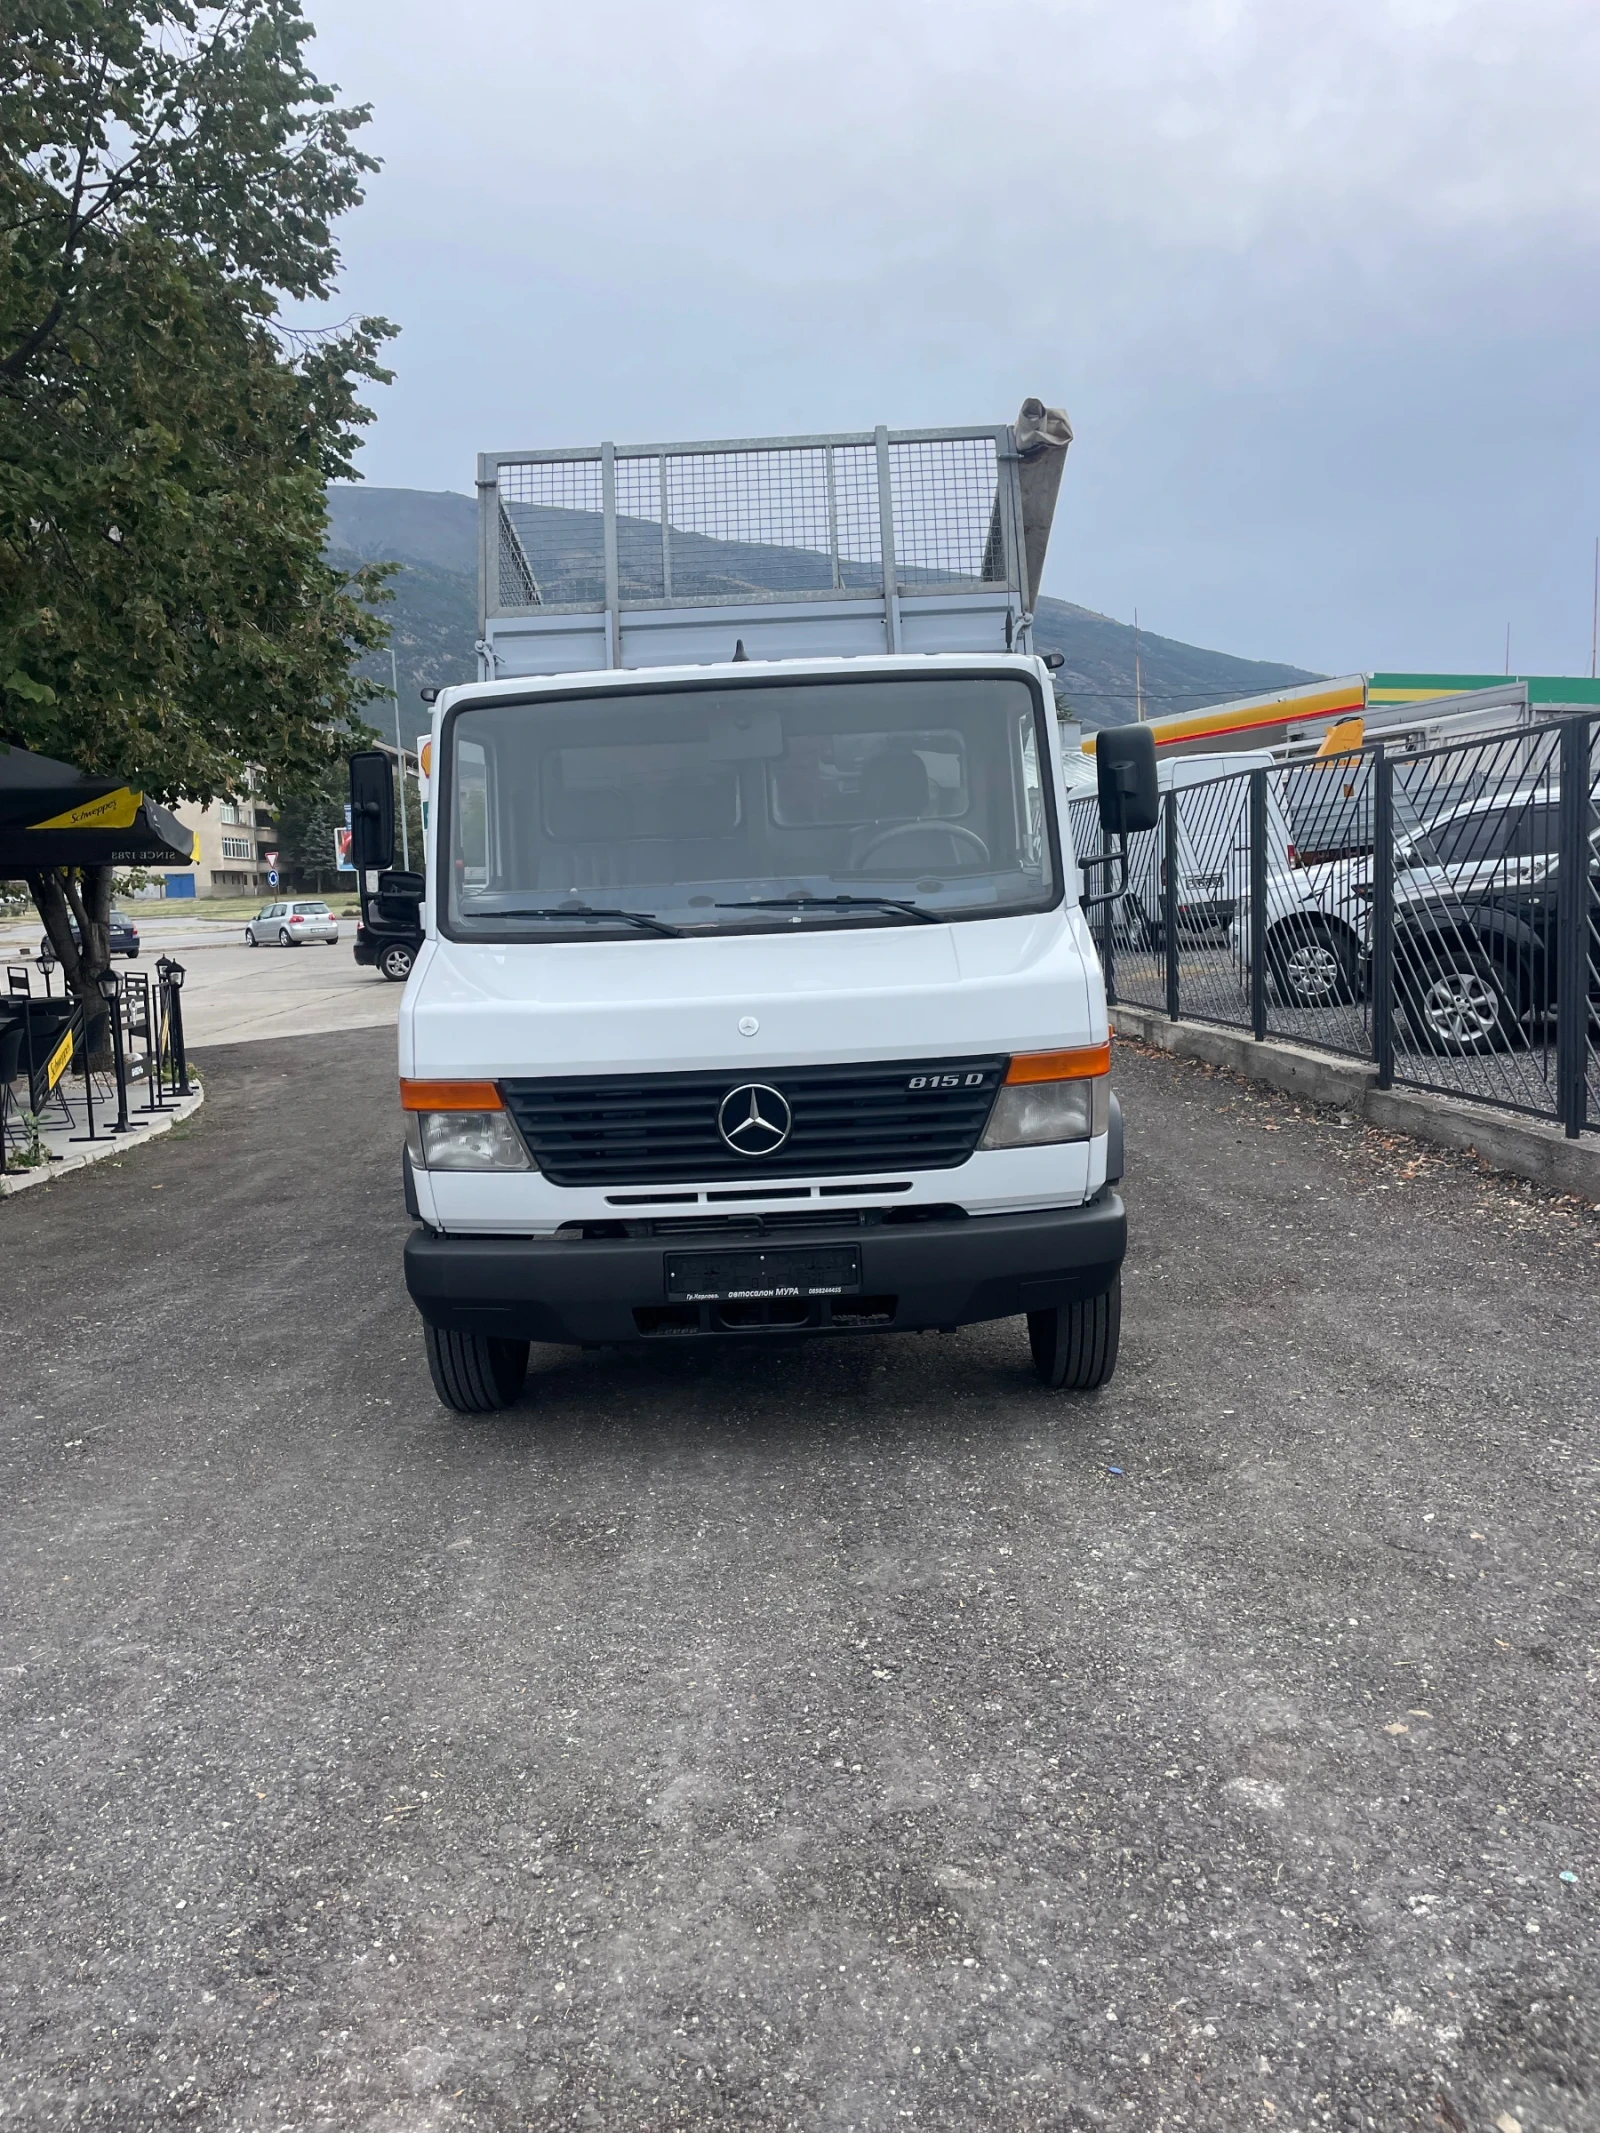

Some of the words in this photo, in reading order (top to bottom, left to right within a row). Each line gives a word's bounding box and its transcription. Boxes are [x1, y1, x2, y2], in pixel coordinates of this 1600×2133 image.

[70, 800, 117, 824] Schweppes
[908, 1074, 960, 1089] 815
[964, 1073, 984, 1086] D
[728, 1289, 774, 1299] автосалон
[775, 1287, 799, 1296] МУРА
